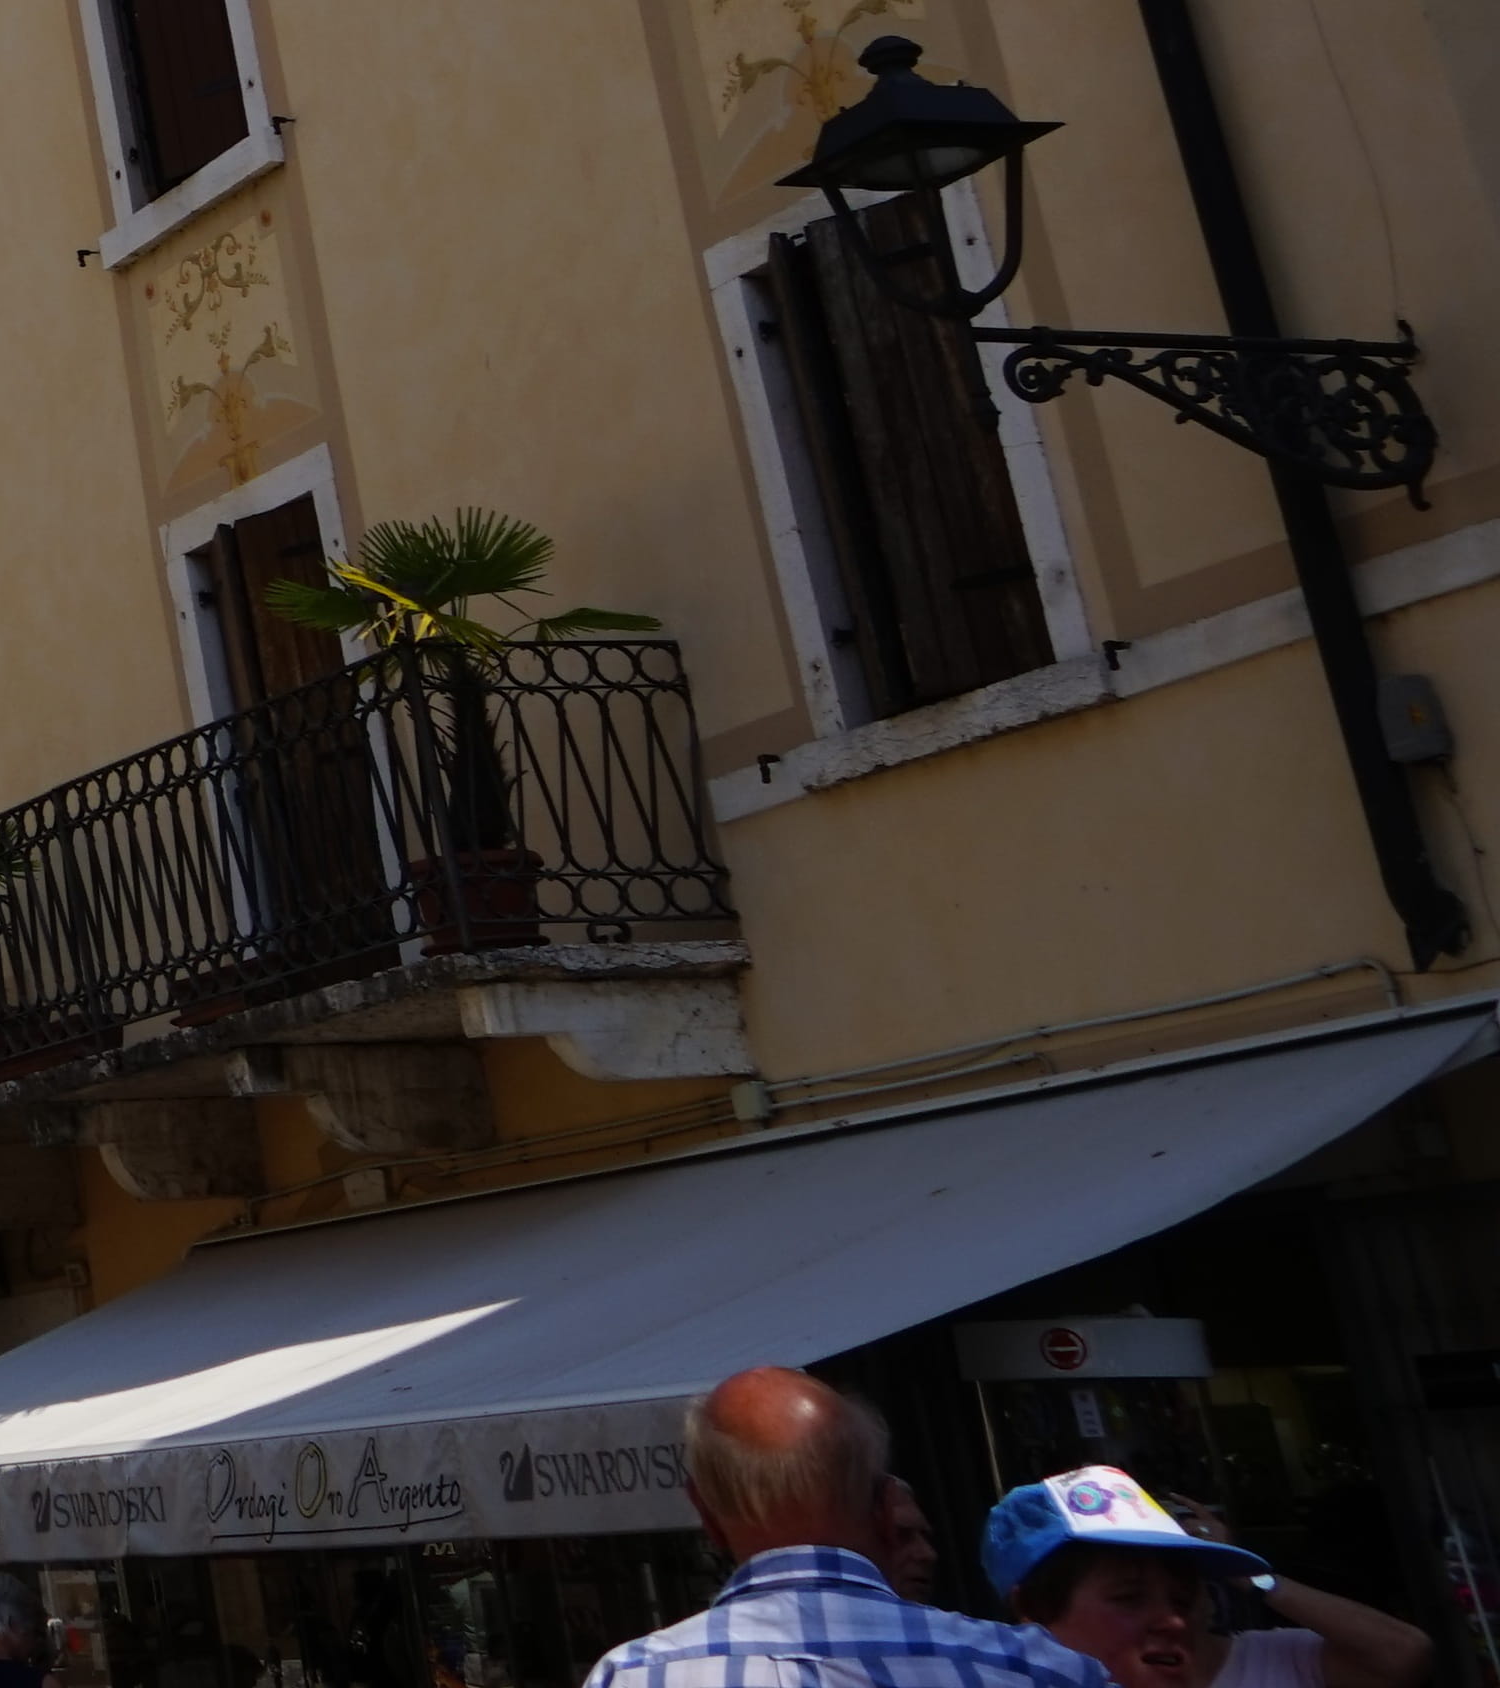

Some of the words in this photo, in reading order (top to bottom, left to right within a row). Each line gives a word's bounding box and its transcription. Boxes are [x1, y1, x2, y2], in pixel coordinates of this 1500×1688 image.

[295, 1441, 343, 1519] Oro
[348, 1437, 461, 1532] Argento
[535, 1443, 689, 1496] SWAROVSK
